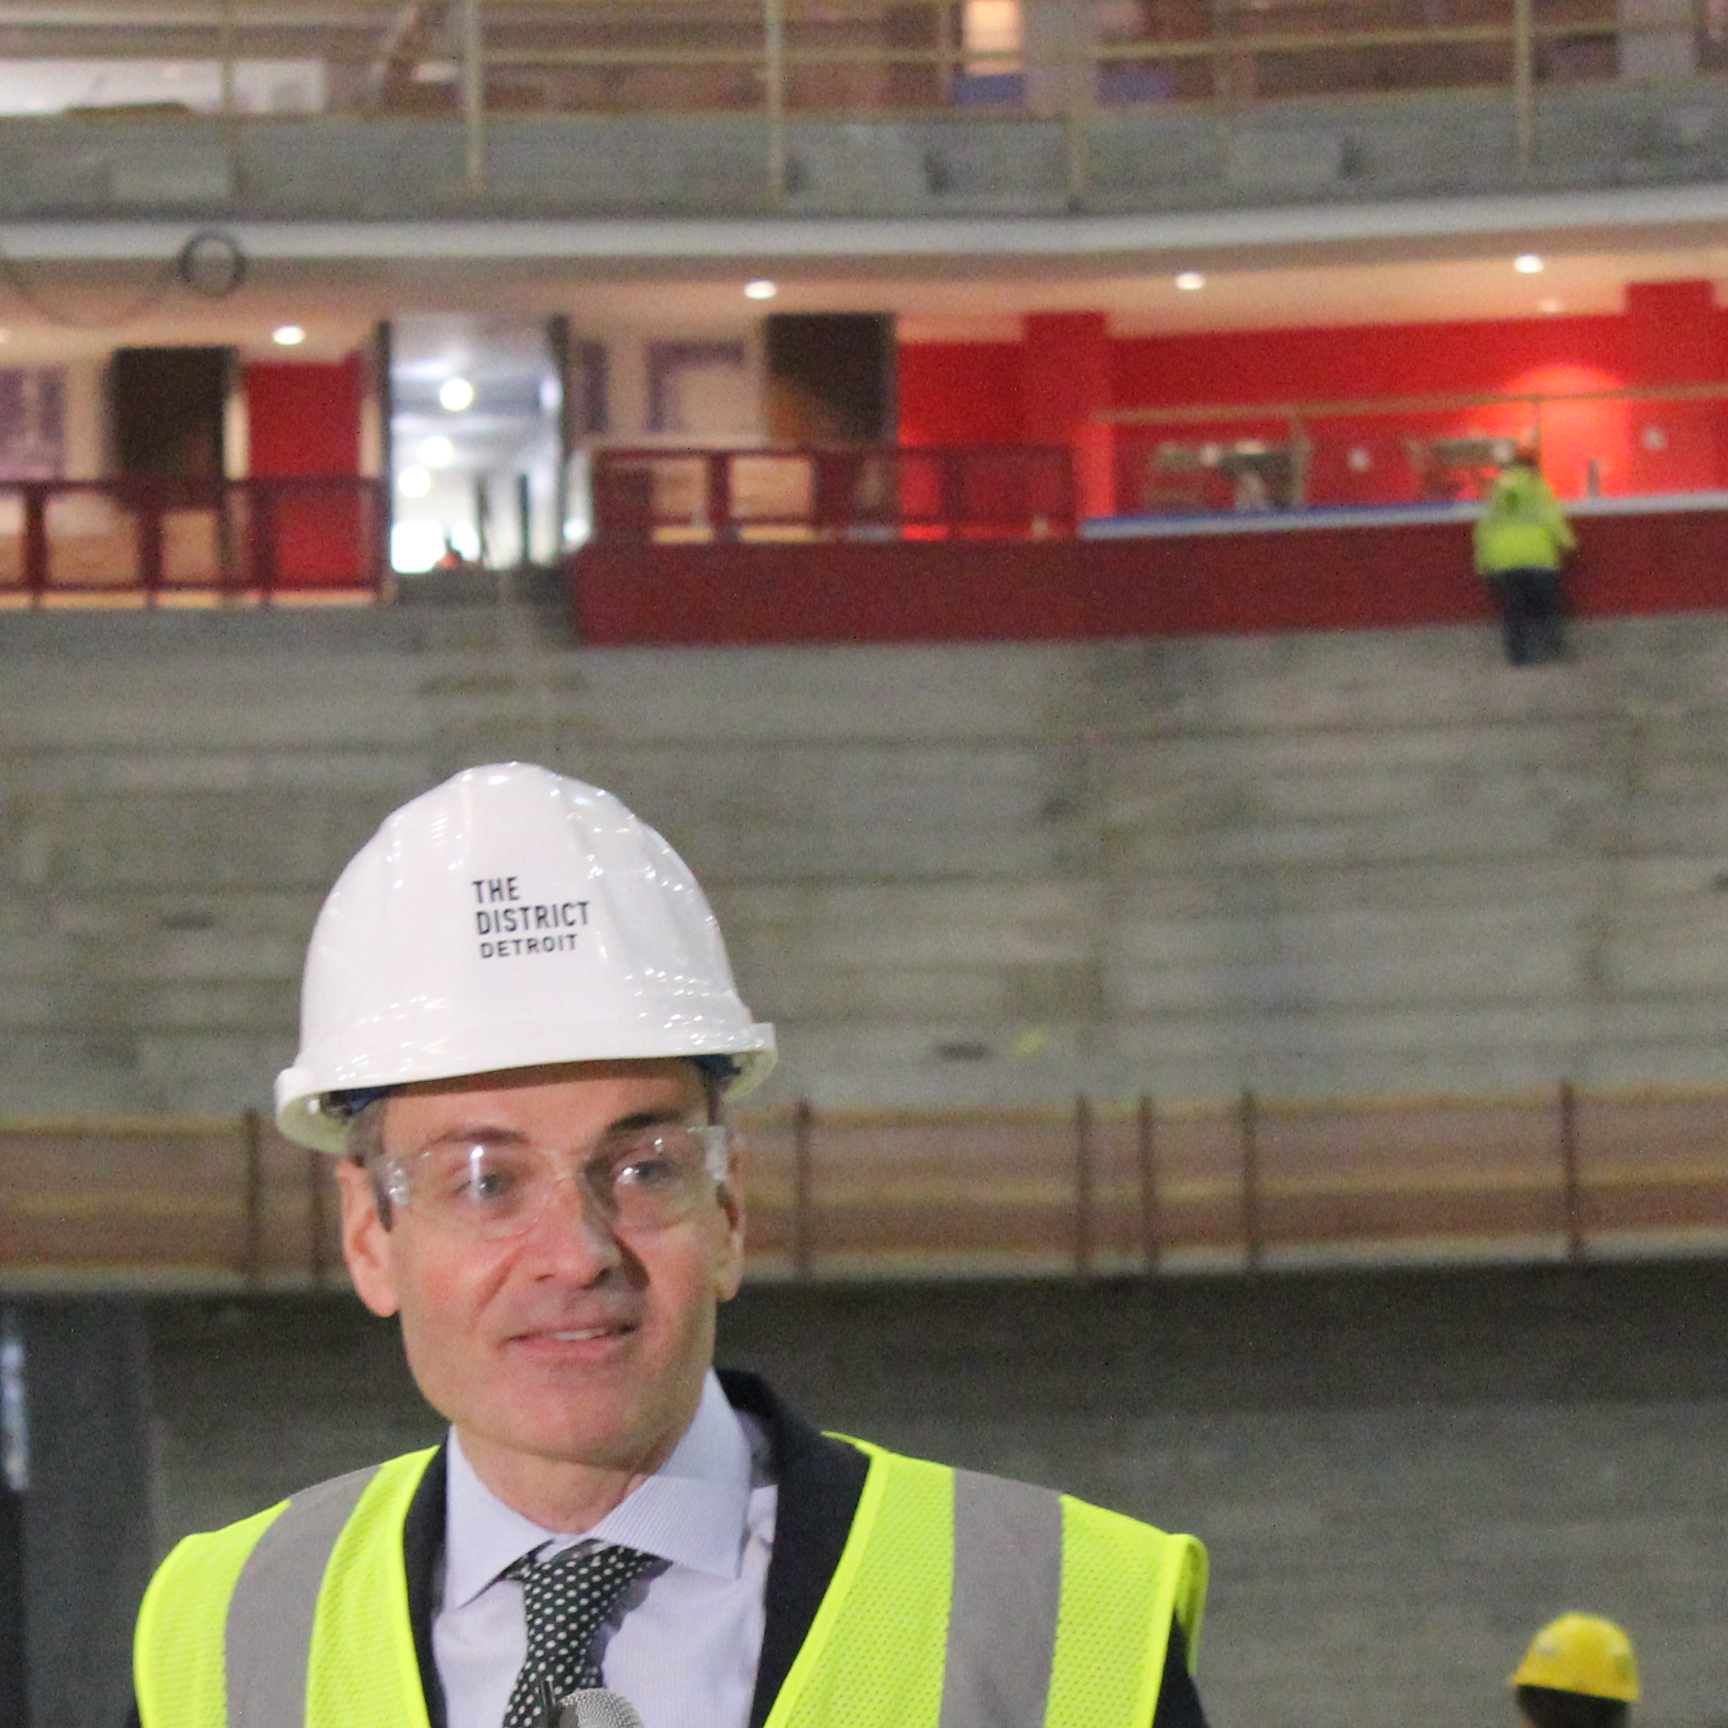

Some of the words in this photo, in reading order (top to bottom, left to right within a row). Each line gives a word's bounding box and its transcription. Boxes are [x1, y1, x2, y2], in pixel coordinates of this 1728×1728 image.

[471, 876, 520, 904] THE
[476, 901, 590, 935] DISTRICT
[480, 934, 578, 959] DETROIT
